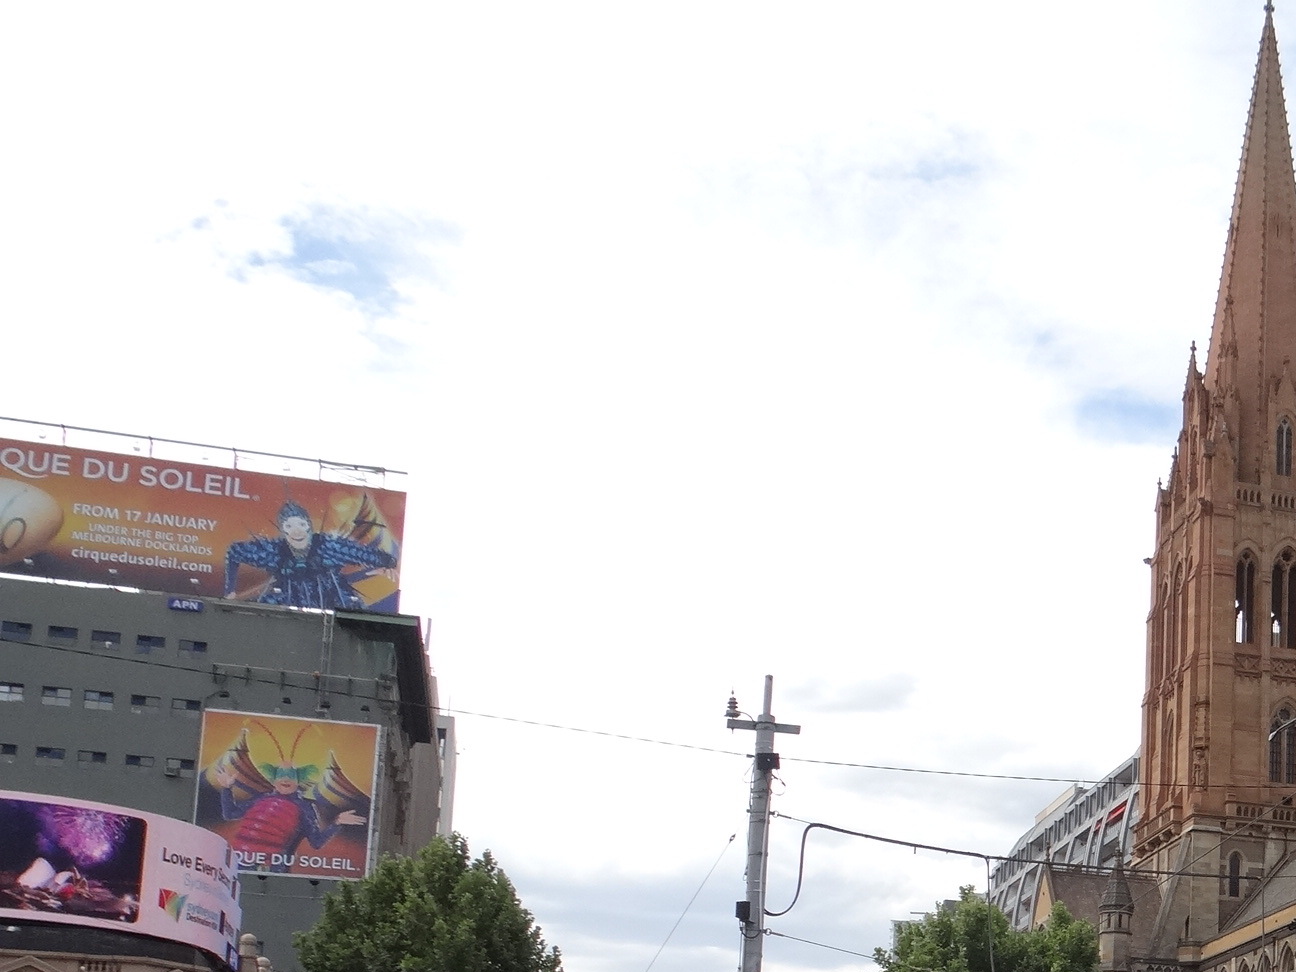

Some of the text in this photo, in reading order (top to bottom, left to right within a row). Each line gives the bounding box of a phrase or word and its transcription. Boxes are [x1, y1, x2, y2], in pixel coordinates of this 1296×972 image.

[0, 447, 250, 499] QUE DU SOLEIL
[72, 503, 218, 532] FROM 17 JANUARY
[72, 531, 213, 556] MELBOURNE DOCKLANDS
[88, 523, 199, 544] UNDER THE BIG TOP
[72, 547, 213, 574] cirquedusoleil.com
[172, 600, 199, 611] APN
[162, 847, 192, 868] Love
[271, 853, 295, 867] DU
[299, 855, 356, 871] SOLEIL
